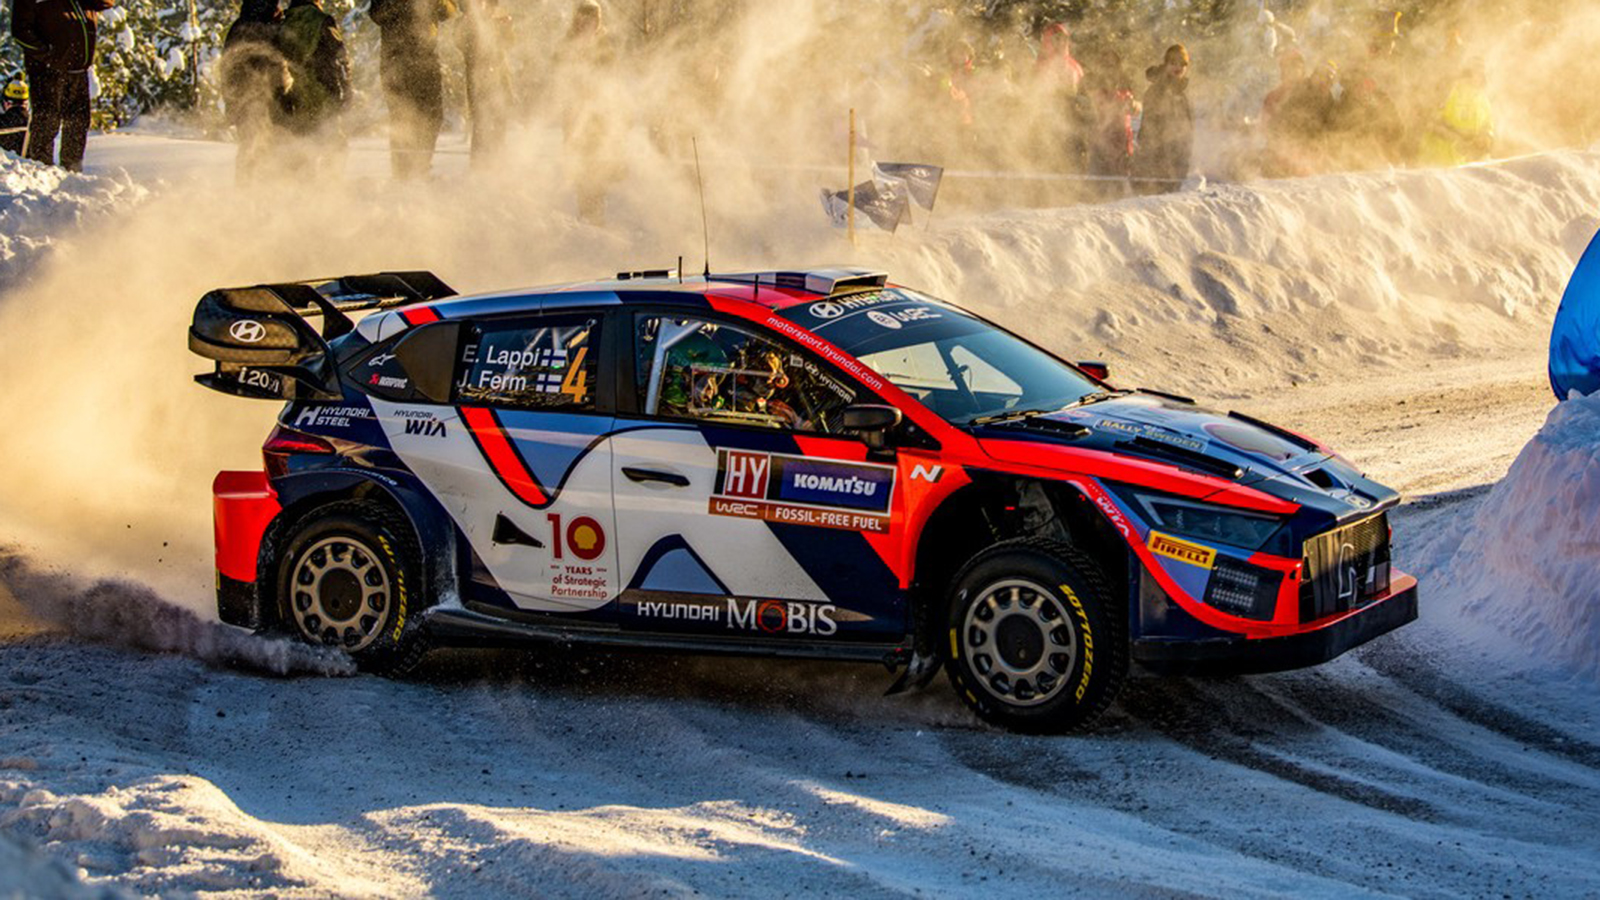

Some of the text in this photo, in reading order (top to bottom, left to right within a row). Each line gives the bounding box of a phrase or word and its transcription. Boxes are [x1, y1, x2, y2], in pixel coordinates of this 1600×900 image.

[462, 344, 540, 369] E. Lappi
[767, 316, 883, 390] motorsport.hyundai.com
[457, 369, 527, 391] J. Ferm
[561, 347, 588, 403] 4
[819, 373, 854, 404] HYUNDAI
[316, 416, 350, 427] STEEL
[320, 406, 371, 418] HYUNDAI
[393, 409, 434, 419] HYUNDAI
[1101, 419, 1201, 449] RALLY SWEDEN
[727, 455, 767, 495] HY
[793, 474, 876, 496] KOMATSU
[775, 507, 850, 527] FOSSIL-FREE
[852, 516, 882, 531] FUEL
[547, 513, 606, 561] 10
[1152, 535, 1210, 564] PIRELLI
[552, 574, 607, 588] of Strategic
[565, 565, 592, 575] YEARS
[551, 586, 608, 599] Partnership
[637, 598, 837, 635] HYUNDAI MOBIS
[1059, 584, 1094, 704] SOTTOZERO
